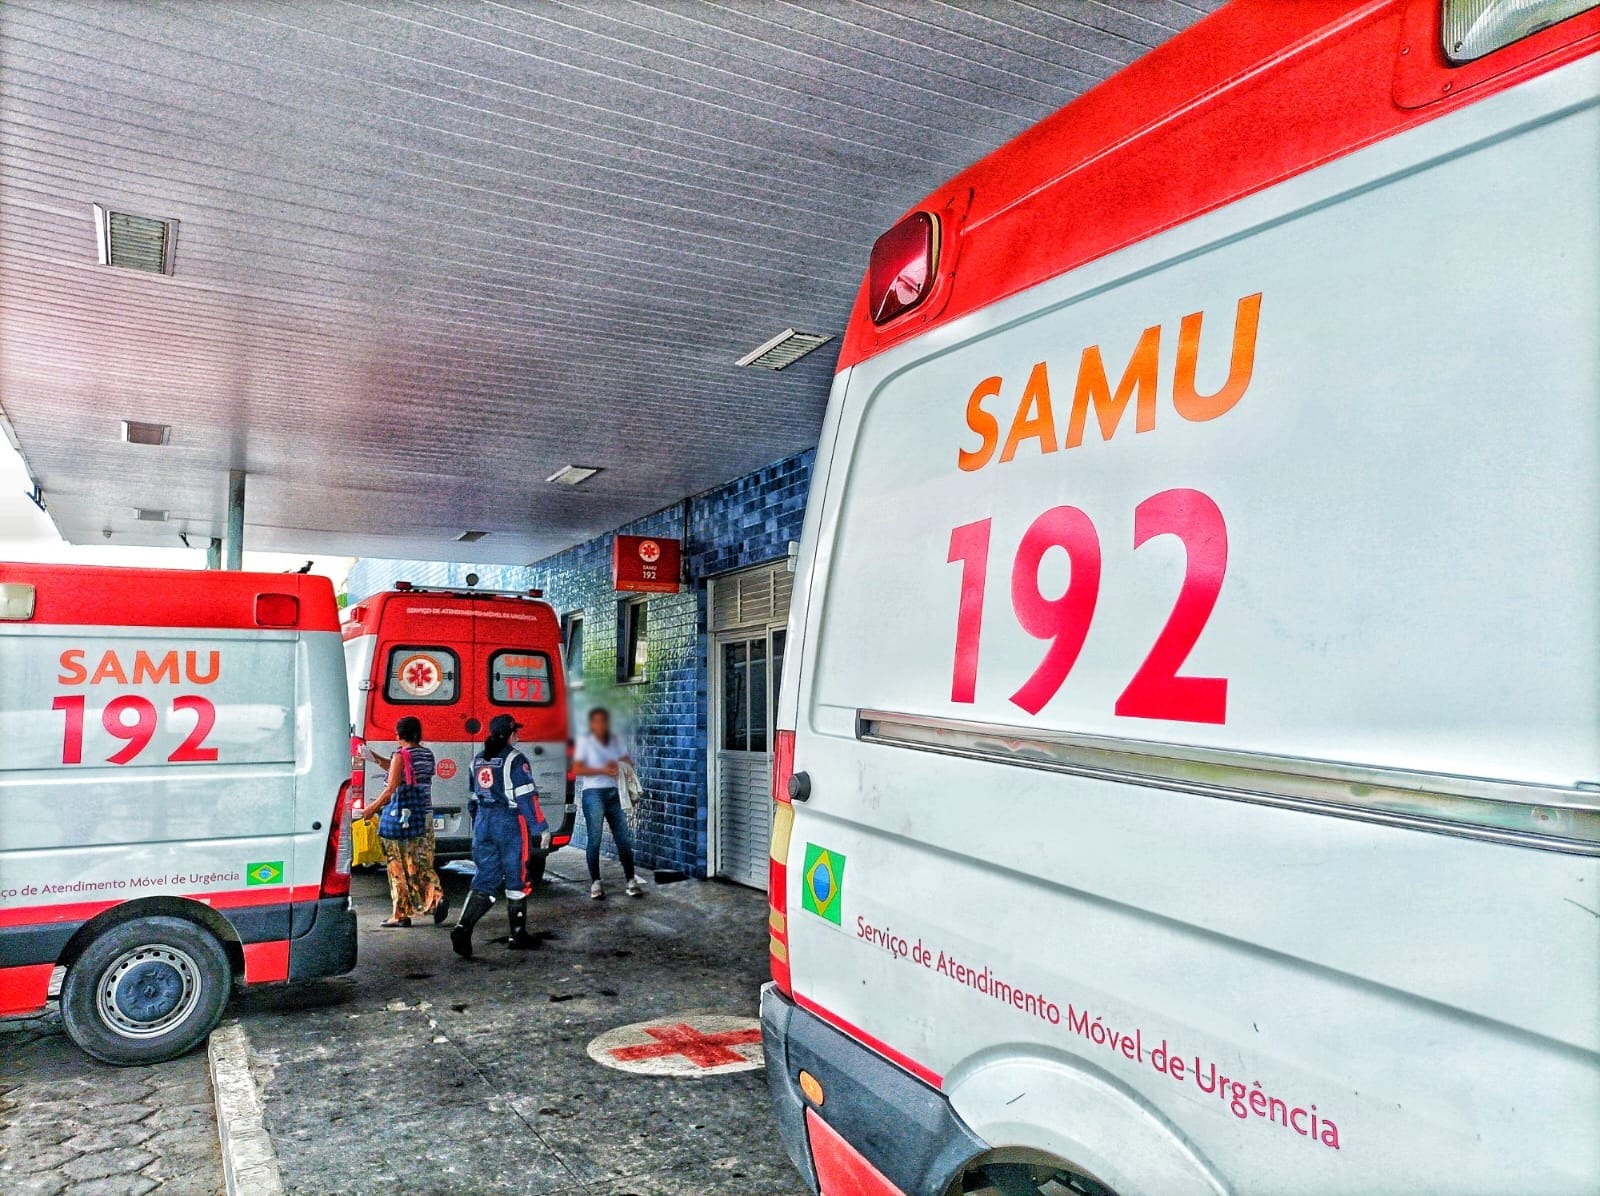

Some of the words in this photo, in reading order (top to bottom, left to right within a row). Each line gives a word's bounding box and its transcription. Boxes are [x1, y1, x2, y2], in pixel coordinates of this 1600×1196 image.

[958, 292, 1263, 472] SAMU
[642, 571, 657, 579] 192
[947, 488, 1228, 725] 192
[57, 648, 221, 685] SAMU
[504, 655, 544, 670] SAMU
[504, 676, 544, 700] 192
[51, 694, 219, 765] 192
[21, 884, 39, 896] de
[41, 879, 127, 895] Atendimento
[129, 874, 168, 888] Móvel
[171, 874, 186, 885] de
[189, 871, 240, 886] Urgência
[856, 915, 908, 959] Serviço
[912, 938, 932, 968] de
[936, 950, 1061, 1025] Atendimento
[1067, 1003, 1143, 1063] Móvel
[1150, 1039, 1185, 1081] de
[1194, 1055, 1341, 1150] Urgência
